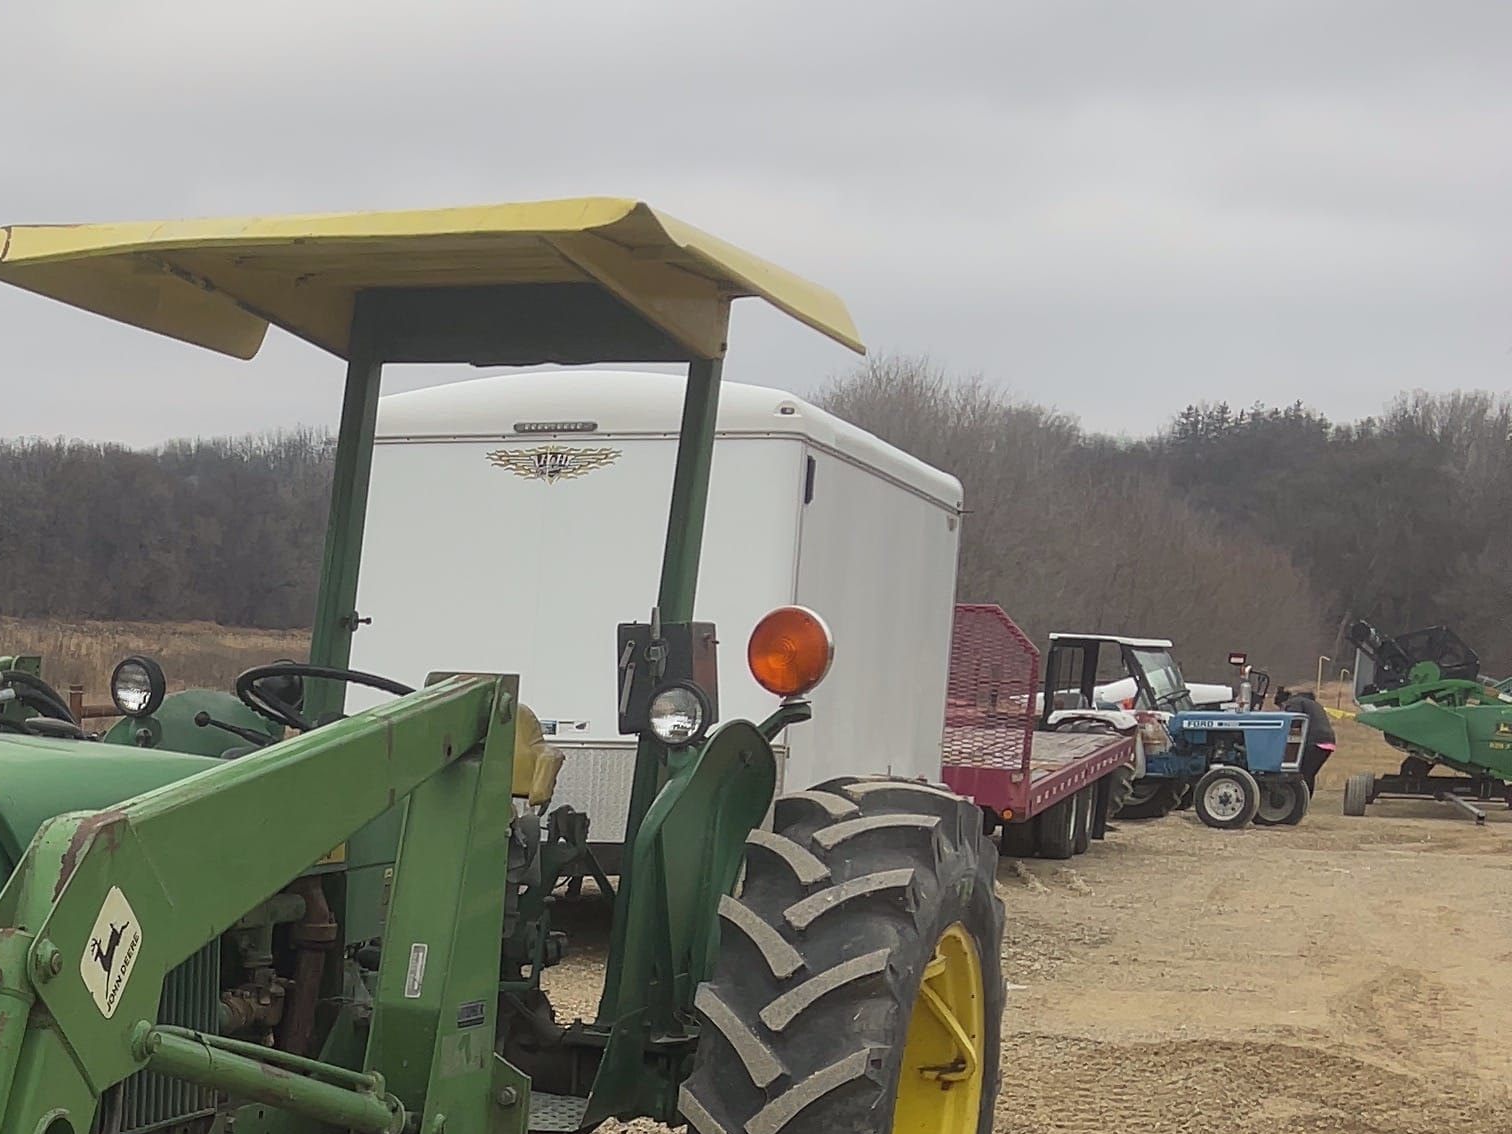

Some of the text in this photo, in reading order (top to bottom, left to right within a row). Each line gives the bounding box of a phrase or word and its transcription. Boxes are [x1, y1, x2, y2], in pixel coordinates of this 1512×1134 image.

[1187, 720, 1214, 728] FORD
[106, 931, 140, 1013] JOHN DEERE
